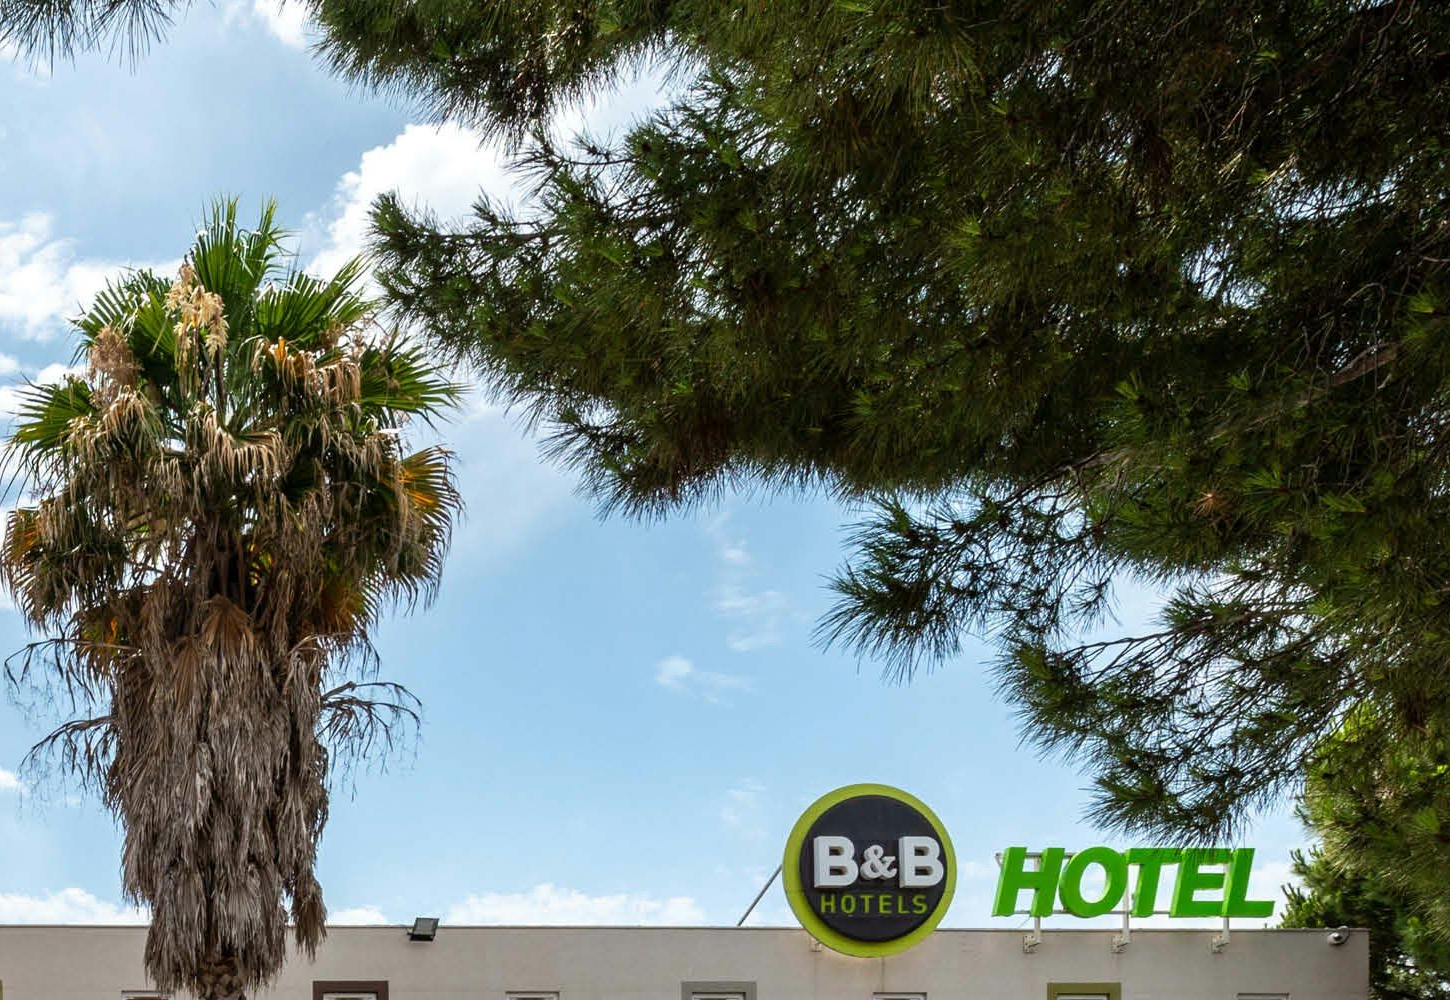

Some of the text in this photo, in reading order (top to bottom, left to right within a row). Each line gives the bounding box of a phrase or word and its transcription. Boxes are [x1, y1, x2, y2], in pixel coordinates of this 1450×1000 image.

[813, 835, 945, 888] B&B
[991, 846, 1276, 918] HOTEL
[820, 894, 929, 915] HOTELS
